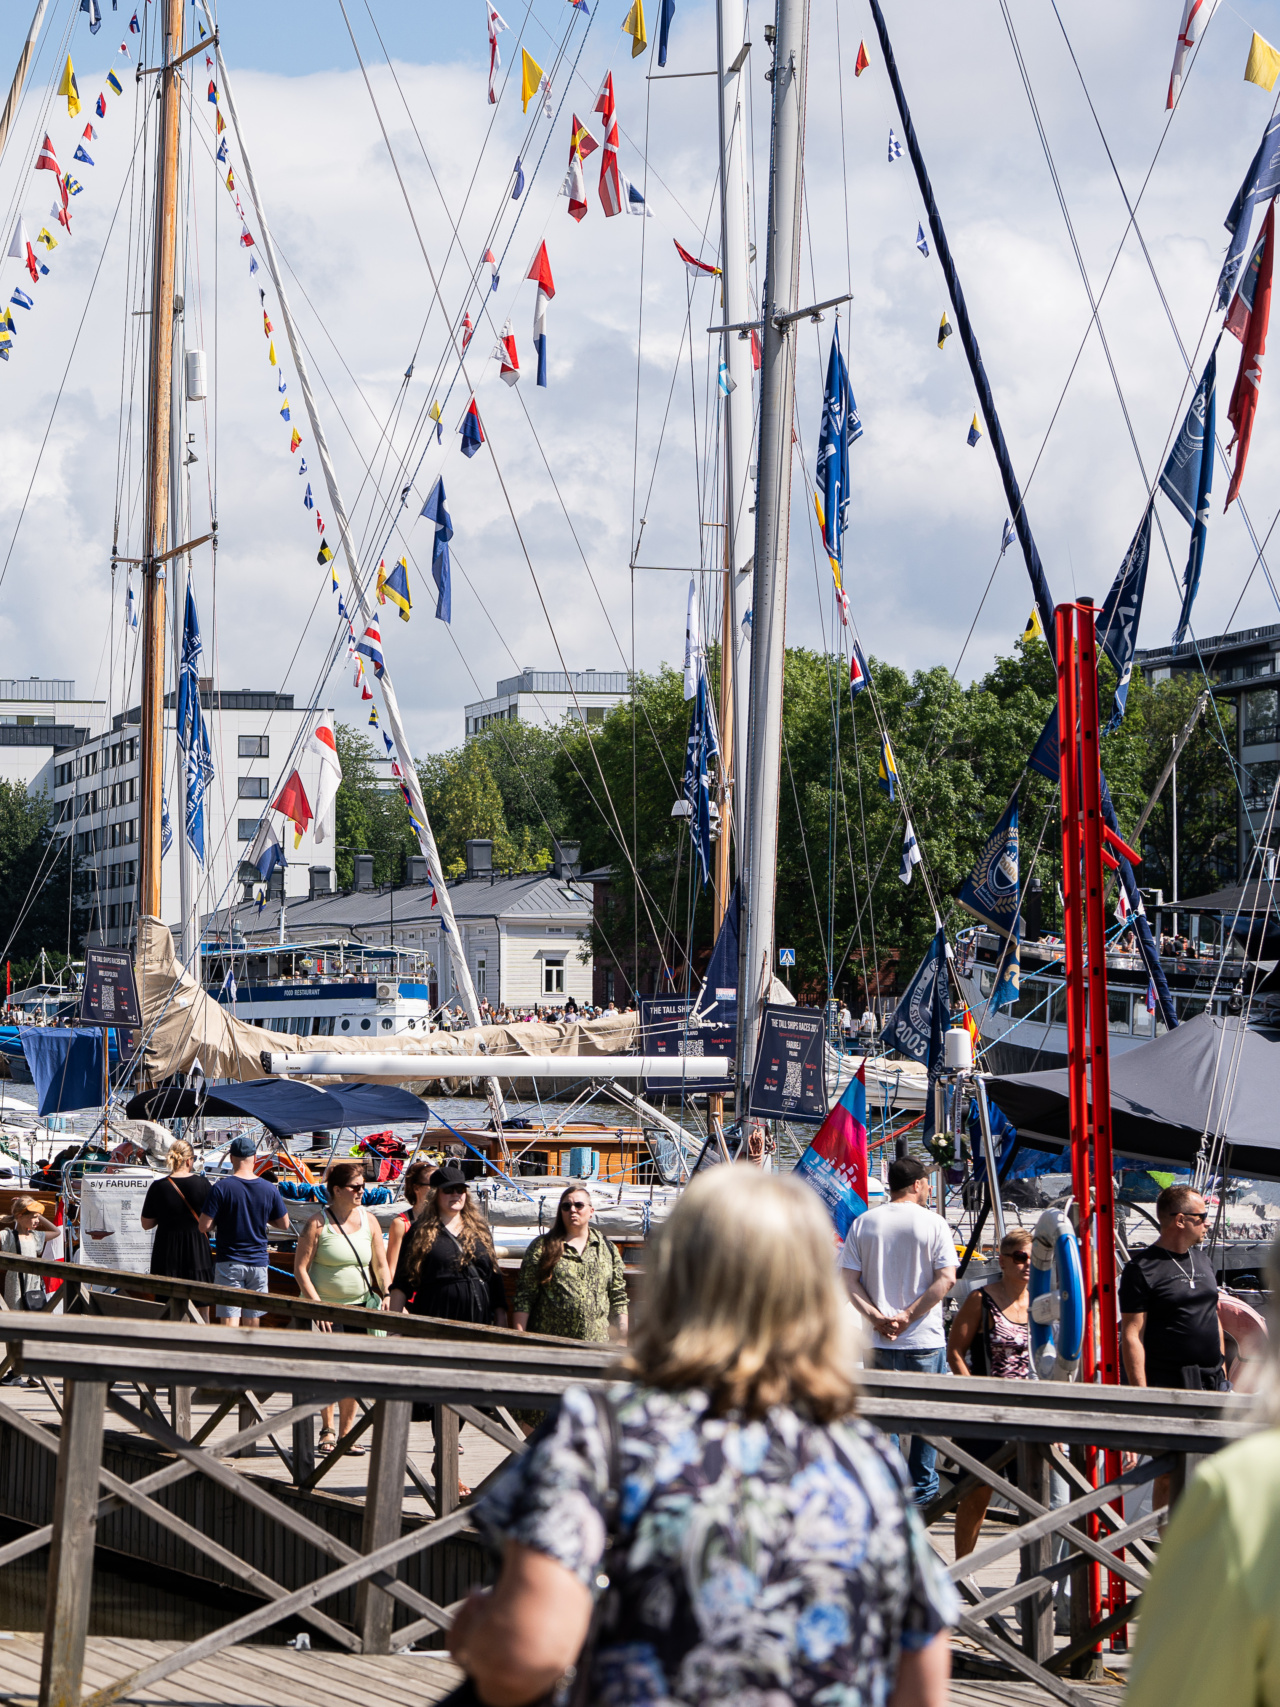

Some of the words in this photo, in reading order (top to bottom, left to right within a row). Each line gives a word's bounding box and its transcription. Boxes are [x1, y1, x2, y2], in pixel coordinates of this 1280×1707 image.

[663, 1006, 676, 1014] TALL
[894, 1020, 928, 1057] 2003
[106, 1180, 148, 1188] FARUREJ
